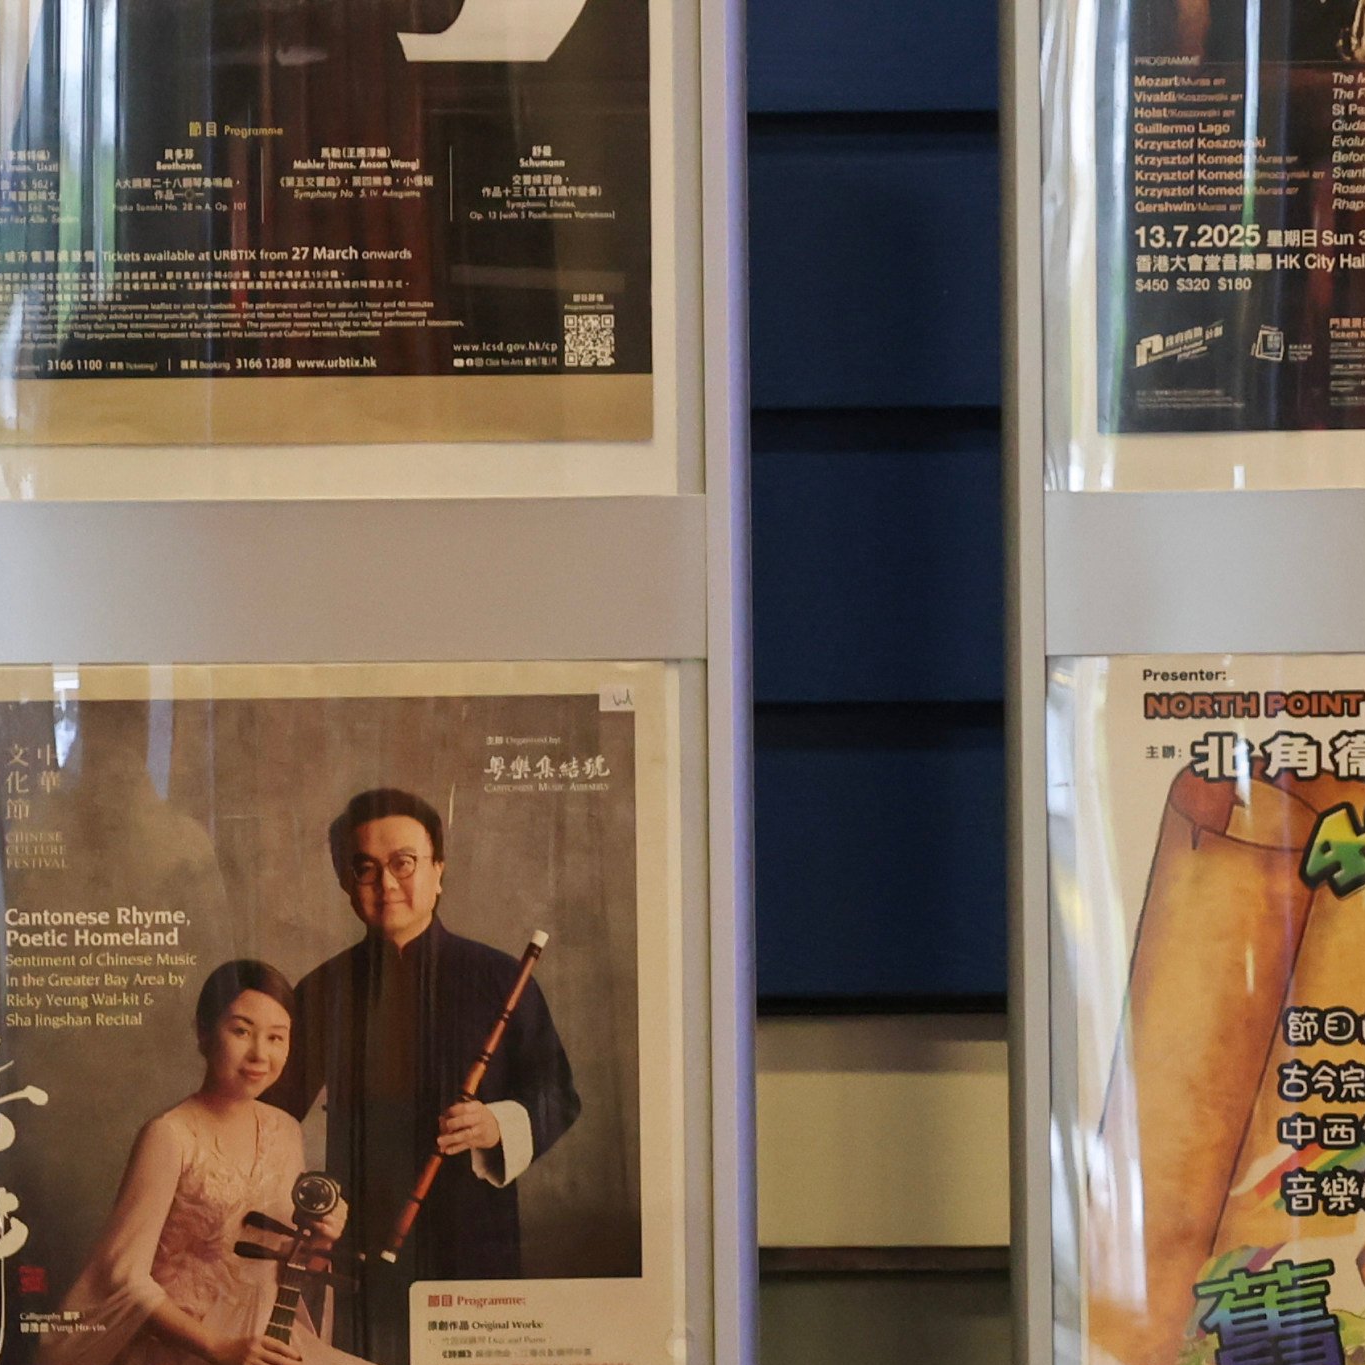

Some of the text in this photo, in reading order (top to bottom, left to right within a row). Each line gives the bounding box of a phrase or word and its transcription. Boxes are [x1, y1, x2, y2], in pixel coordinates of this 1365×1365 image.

[1332, 72, 1354, 84] The
[225, 125, 284, 138] Programme
[1135, 122, 1230, 136] Guillermo Lago
[519, 157, 565, 168] Schumann
[1135, 224, 1261, 248] 13.7.2025
[1266, 230, 1318, 248] 星期日
[1322, 230, 1354, 246] Sun
[103, 246, 412, 262] Tickets available at URBTIX from 27 March onwards
[1276, 254, 1301, 270] HK
[1304, 253, 1335, 273] City
[1134, 276, 1252, 293] $450 $320 $180
[236, 356, 377, 370] 3166 1288 www.urbtix.hk
[1143, 669, 1227, 683] Presenter:
[1143, 691, 1260, 719] NORTH
[5, 906, 191, 929] Cantonese Rhyme,
[6, 927, 178, 947] Poetic Homeland
[6, 952, 197, 967] Sentiment of Chinese Music
[22, 974, 44, 987] the
[48, 973, 100, 987] Greater
[104, 973, 128, 988] Bay
[134, 973, 165, 986] Area
[169, 972, 186, 988] by
[6, 994, 42, 1009] Ricky
[46, 993, 89, 1009] Yeung
[143, 993, 155, 1006] &
[6, 1014, 32, 1027] Sha
[96, 1012, 143, 1027] Recital
